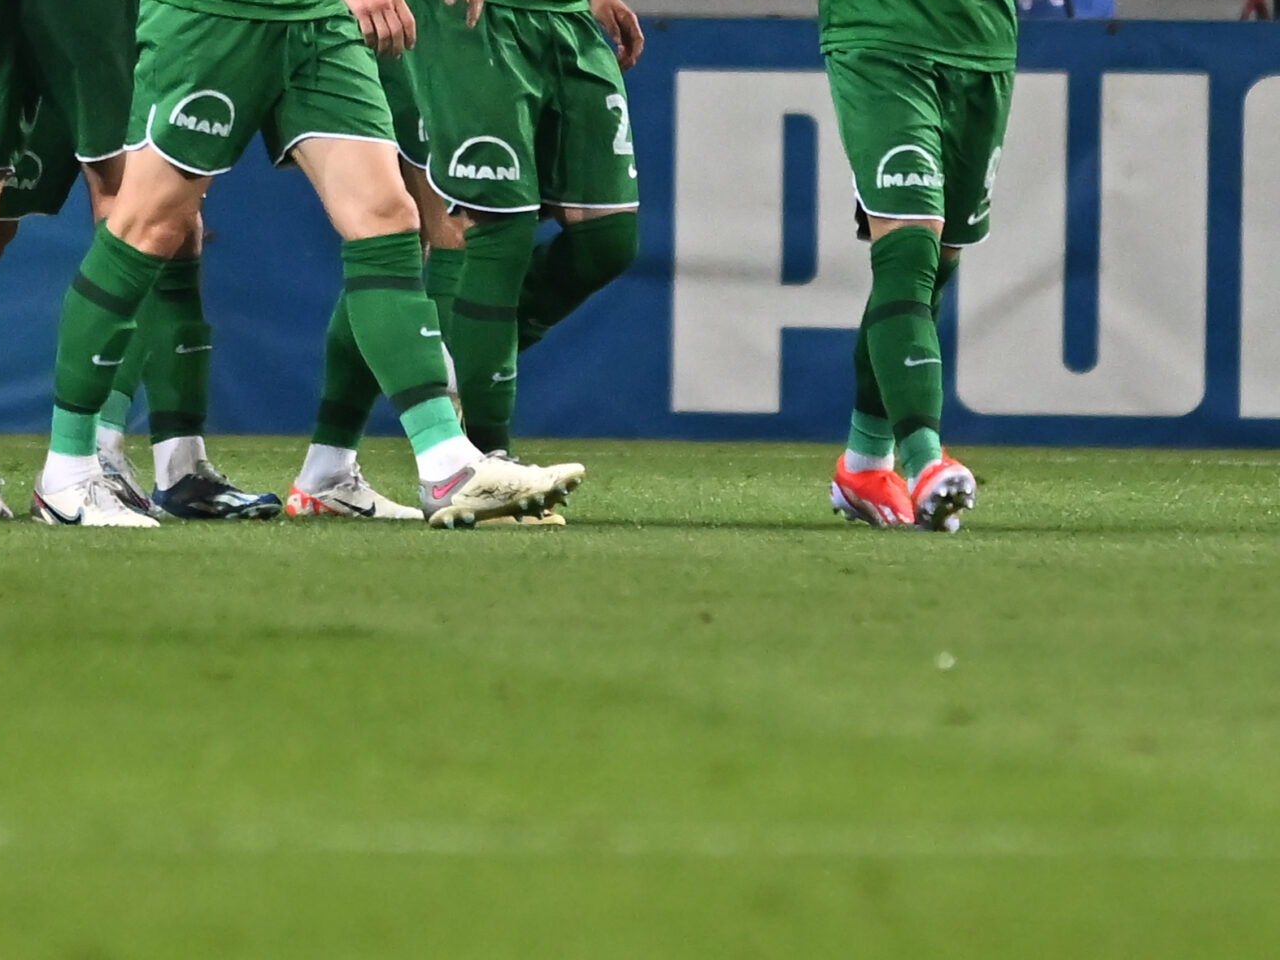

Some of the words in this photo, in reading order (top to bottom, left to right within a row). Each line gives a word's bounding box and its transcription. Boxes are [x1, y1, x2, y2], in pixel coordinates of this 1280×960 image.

[176, 112, 230, 137] MAN
[455, 164, 516, 180] MAN
[883, 173, 942, 188] MAN
